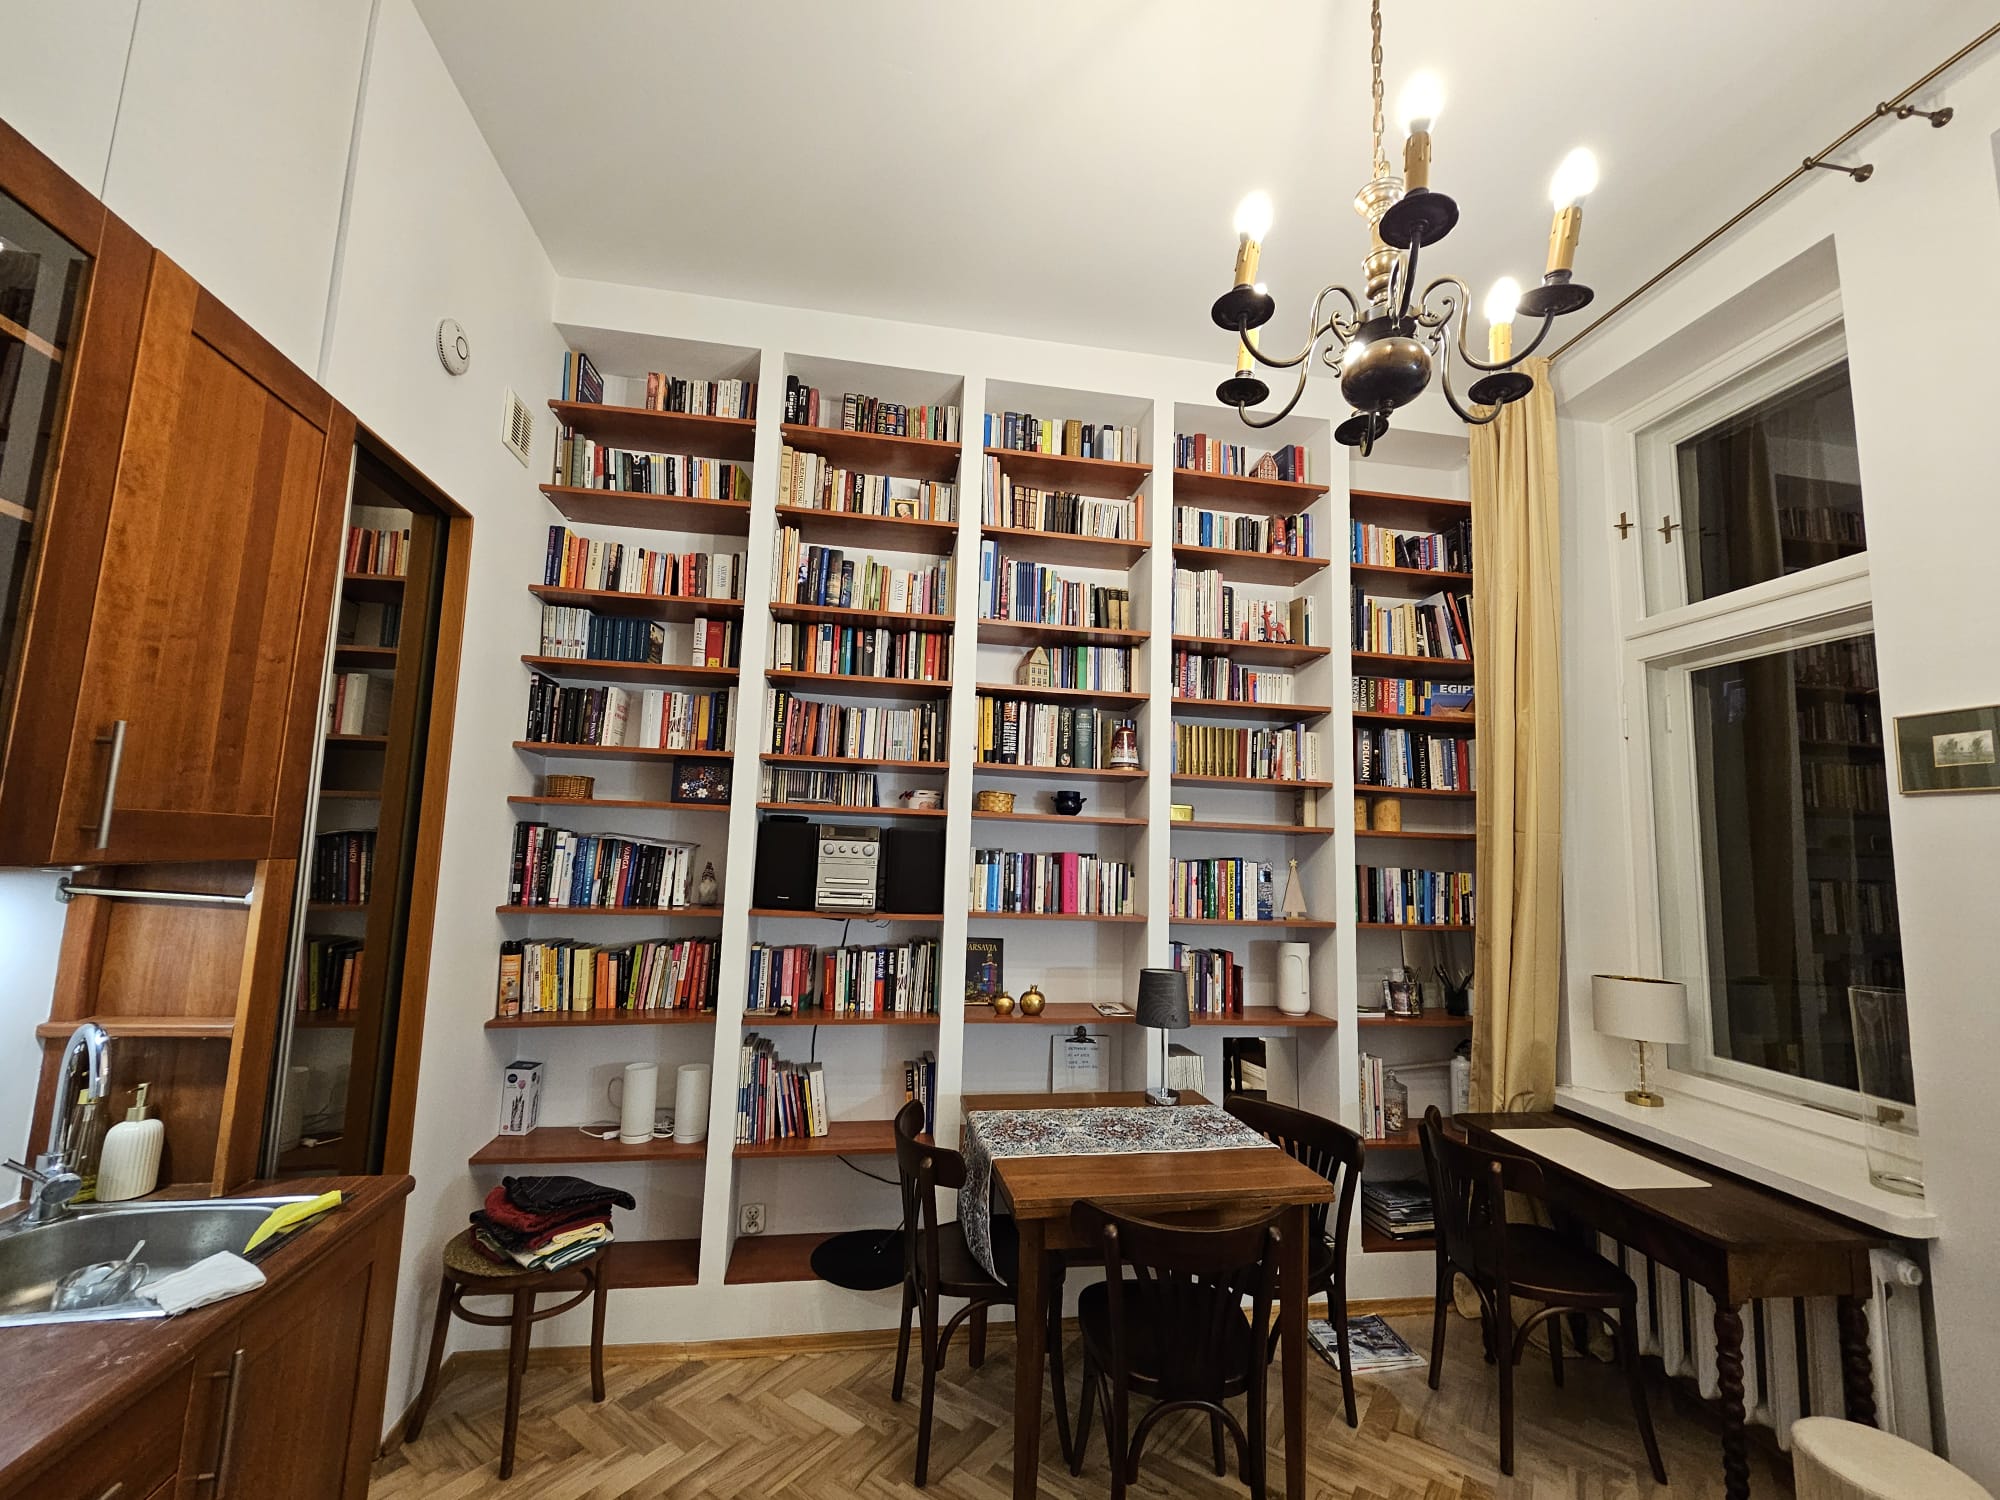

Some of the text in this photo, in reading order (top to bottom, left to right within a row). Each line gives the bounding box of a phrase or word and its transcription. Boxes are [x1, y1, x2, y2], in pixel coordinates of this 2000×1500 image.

[855, 475, 863, 493] MRÓZ
[777, 693, 785, 722] DOKTRYNA
[1362, 740, 1370, 778] EDELMAN
[1419, 748, 1428, 789] DICTIONARY
[539, 850, 549, 887] KATOLICY
[621, 846, 632, 870] VARGA
[967, 943, 998, 952] ARSAVIA
